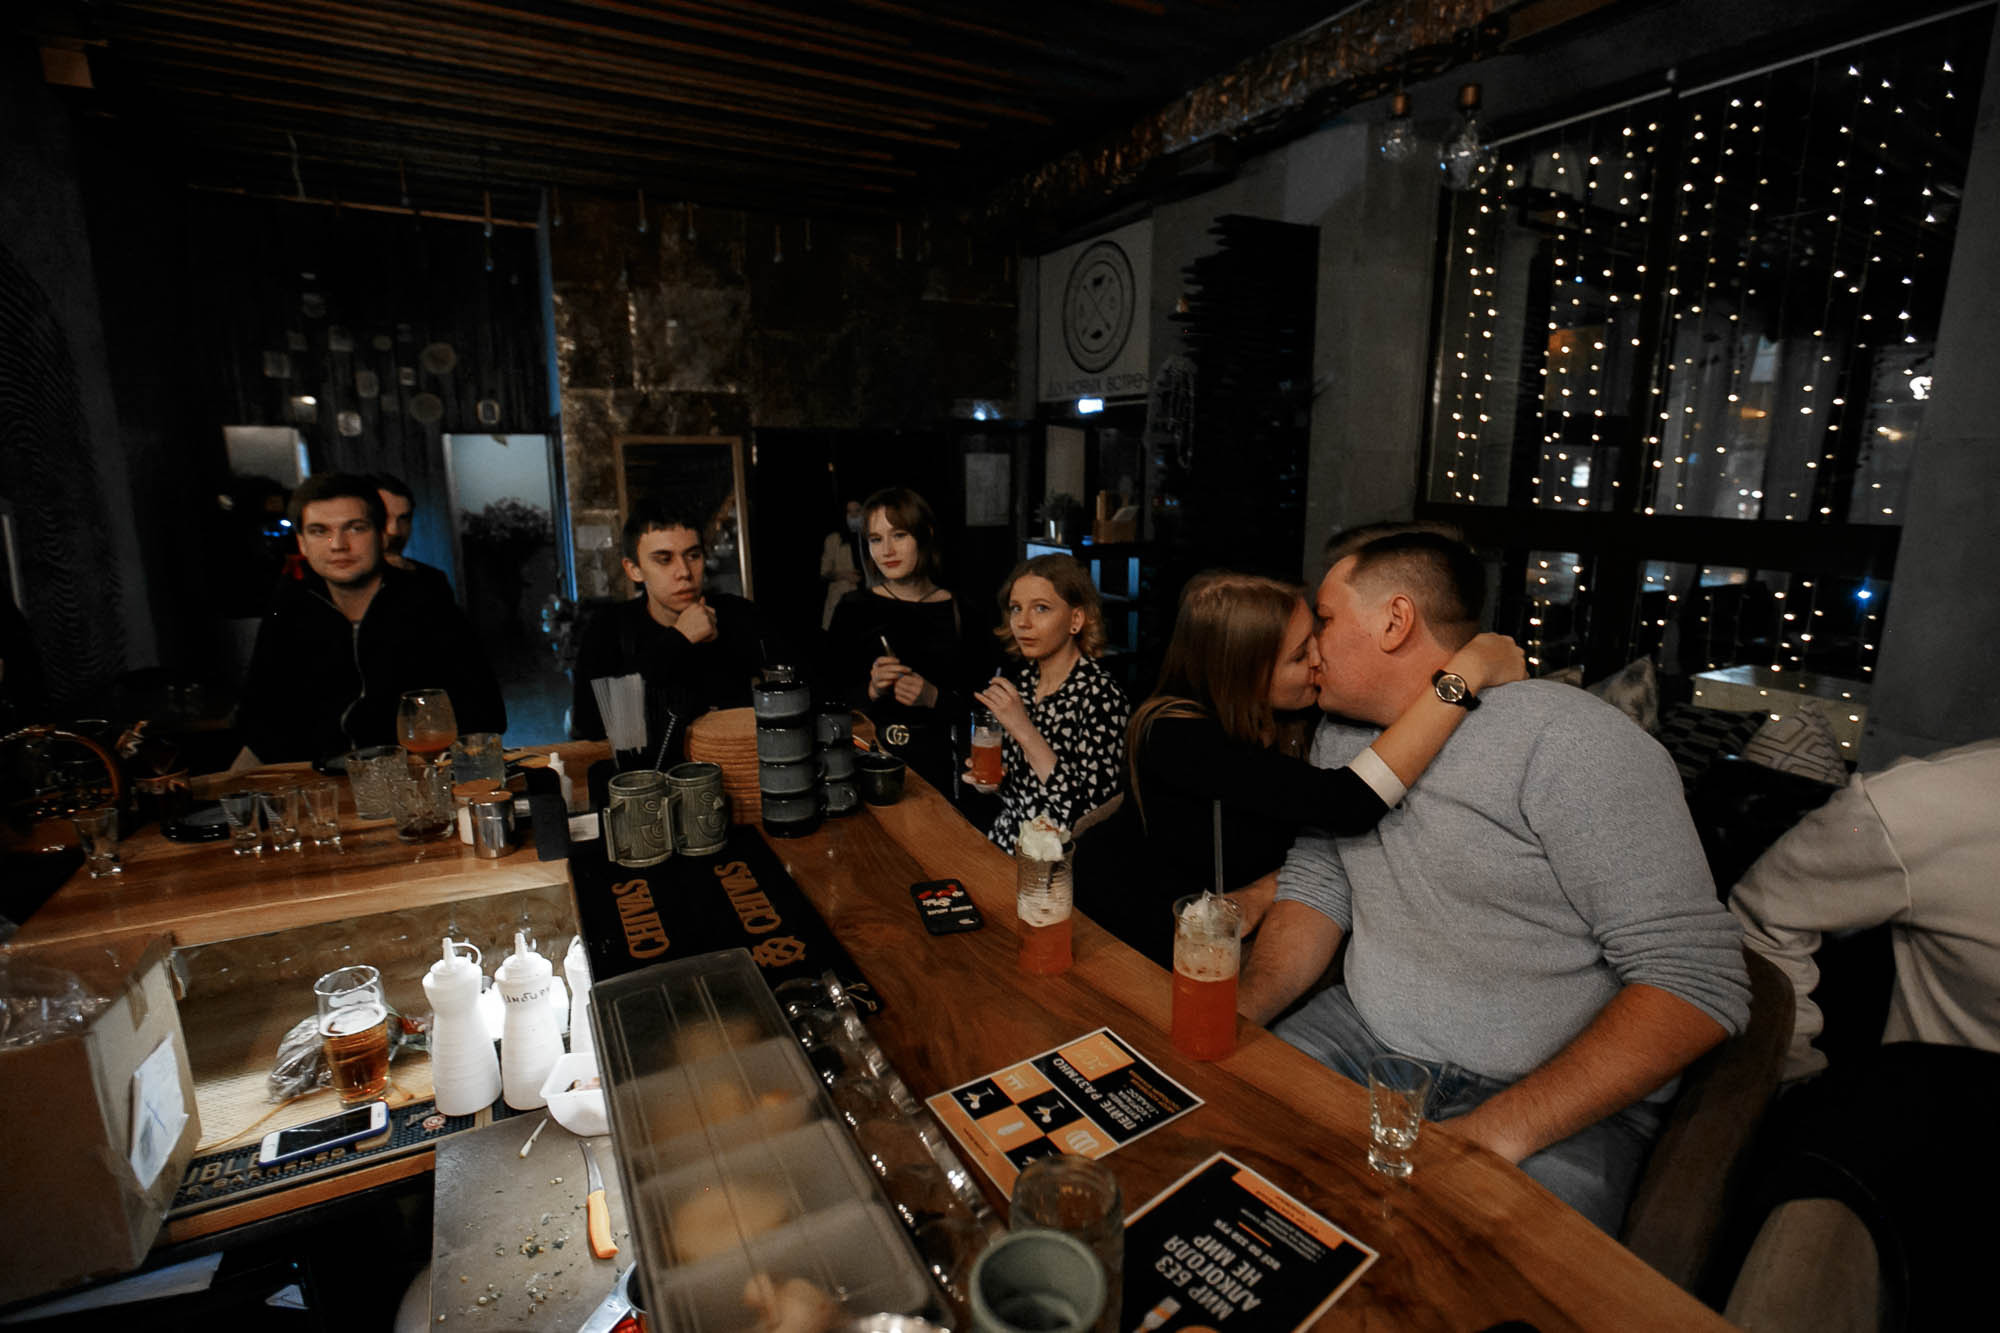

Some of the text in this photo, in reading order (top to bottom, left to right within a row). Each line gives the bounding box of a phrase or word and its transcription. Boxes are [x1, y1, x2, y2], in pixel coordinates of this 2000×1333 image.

[610, 877, 671, 960] CHIVAS
[713, 860, 783, 935] CHIVAS
[1051, 1056, 1103, 1101] РАЗУМНО
[1099, 1098, 1138, 1131] ПЕЙТЕ
[1162, 1234, 1262, 1312] АЛКОГОЛЯ
[1192, 1234, 1237, 1267] МИР
[1230, 1259, 1263, 1288] НЕ
[1154, 1255, 1235, 1321] МИР БЕЗ
